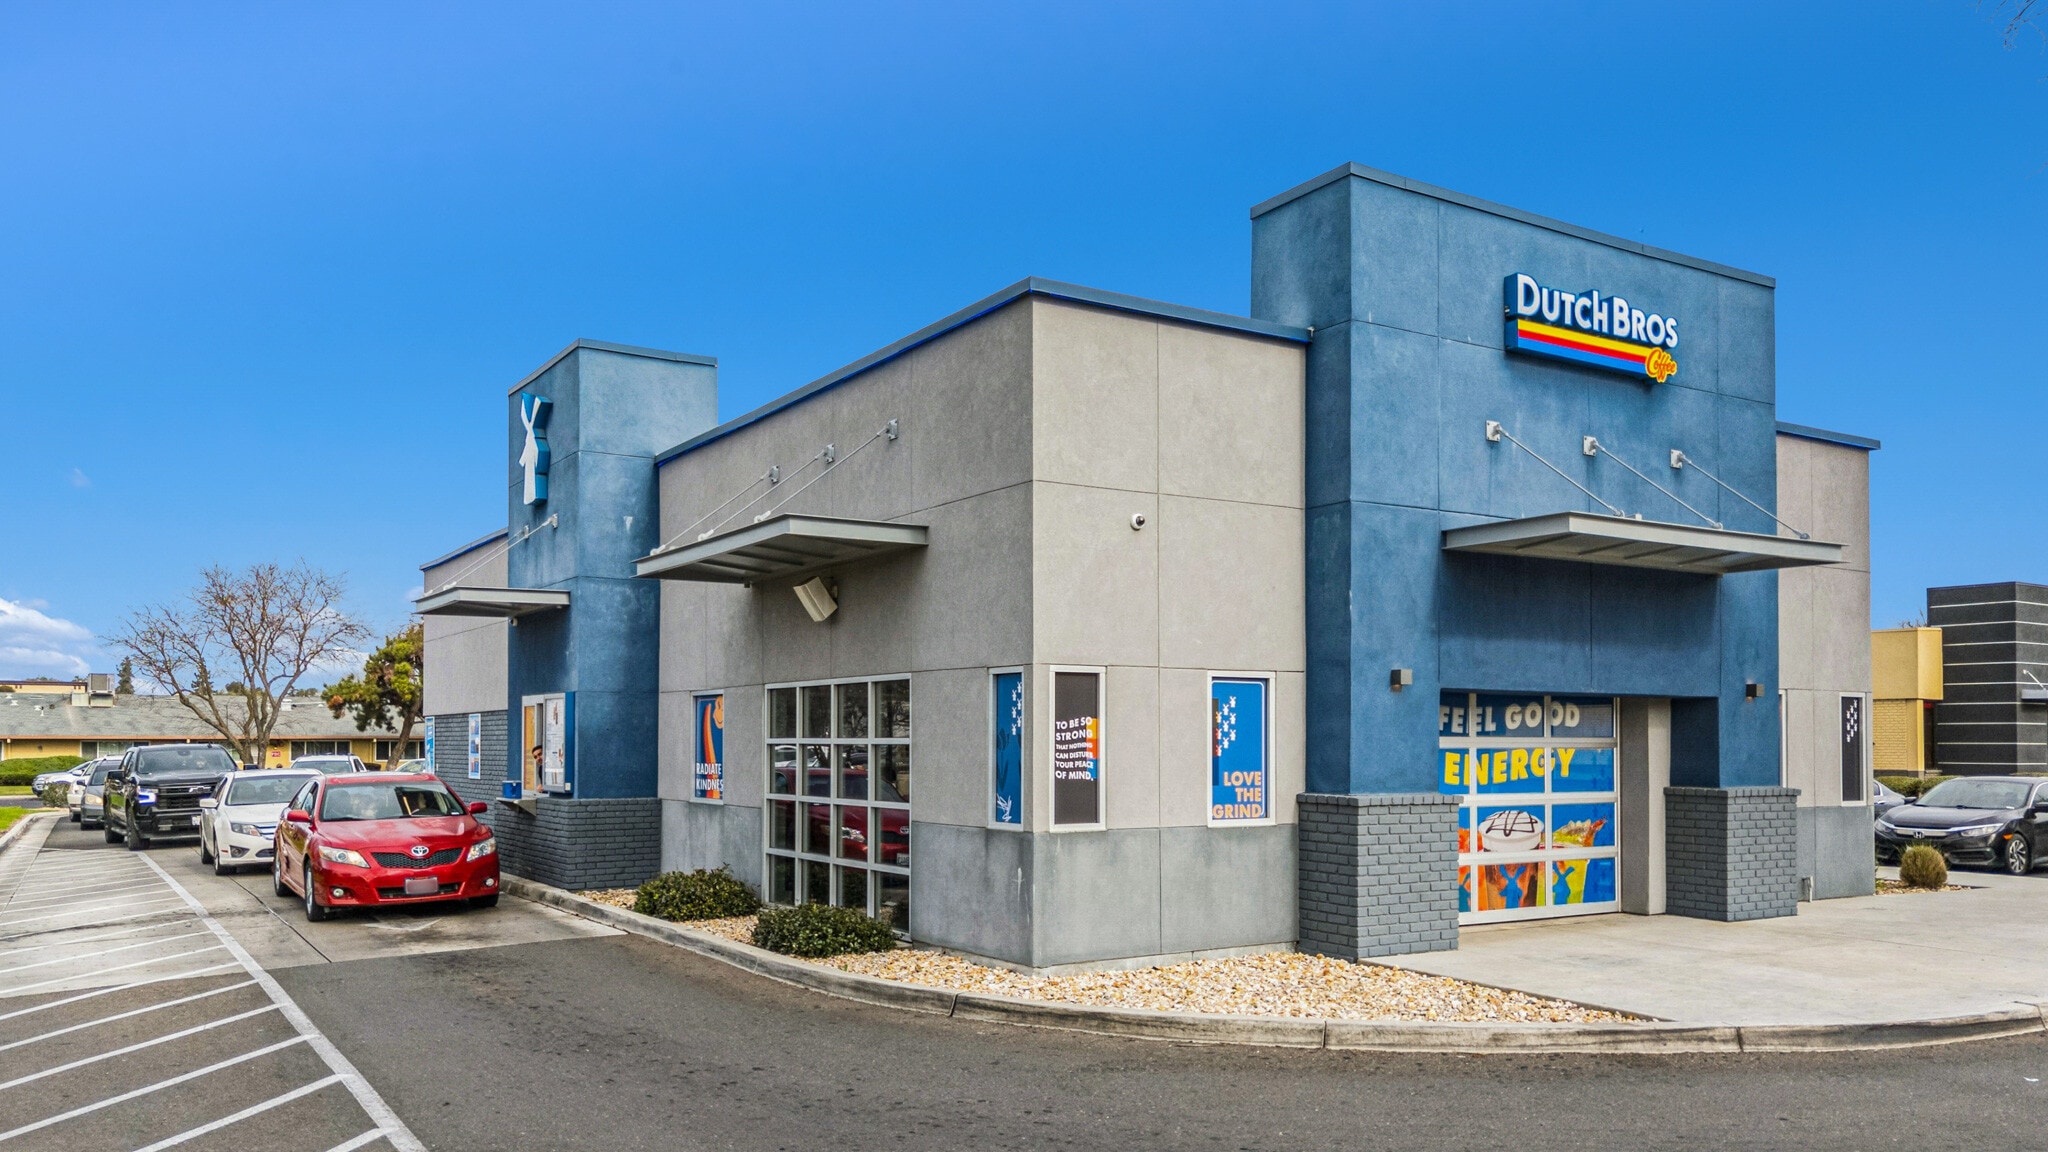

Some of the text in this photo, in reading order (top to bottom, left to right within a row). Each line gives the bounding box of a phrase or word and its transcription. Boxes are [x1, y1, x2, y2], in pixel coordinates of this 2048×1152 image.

[1518, 273, 1678, 348] DUTCH BROS
[1646, 347, 1677, 383] Coffee
[1056, 716, 1093, 730] TO BE SO
[1440, 701, 1580, 734] FEEL GOOD
[1056, 729, 1093, 741] STRONG
[1069, 742, 1093, 750] NOTHING
[1069, 751, 1094, 759] DISTURB
[696, 763, 722, 775] RADIATE
[1075, 761, 1094, 769] PEACE
[1444, 748, 1576, 786] ENERGY
[1055, 770, 1094, 781] OF MIND.
[1223, 771, 1262, 786] LOVE
[1235, 788, 1262, 802] THE
[1212, 804, 1262, 819] GRIND
